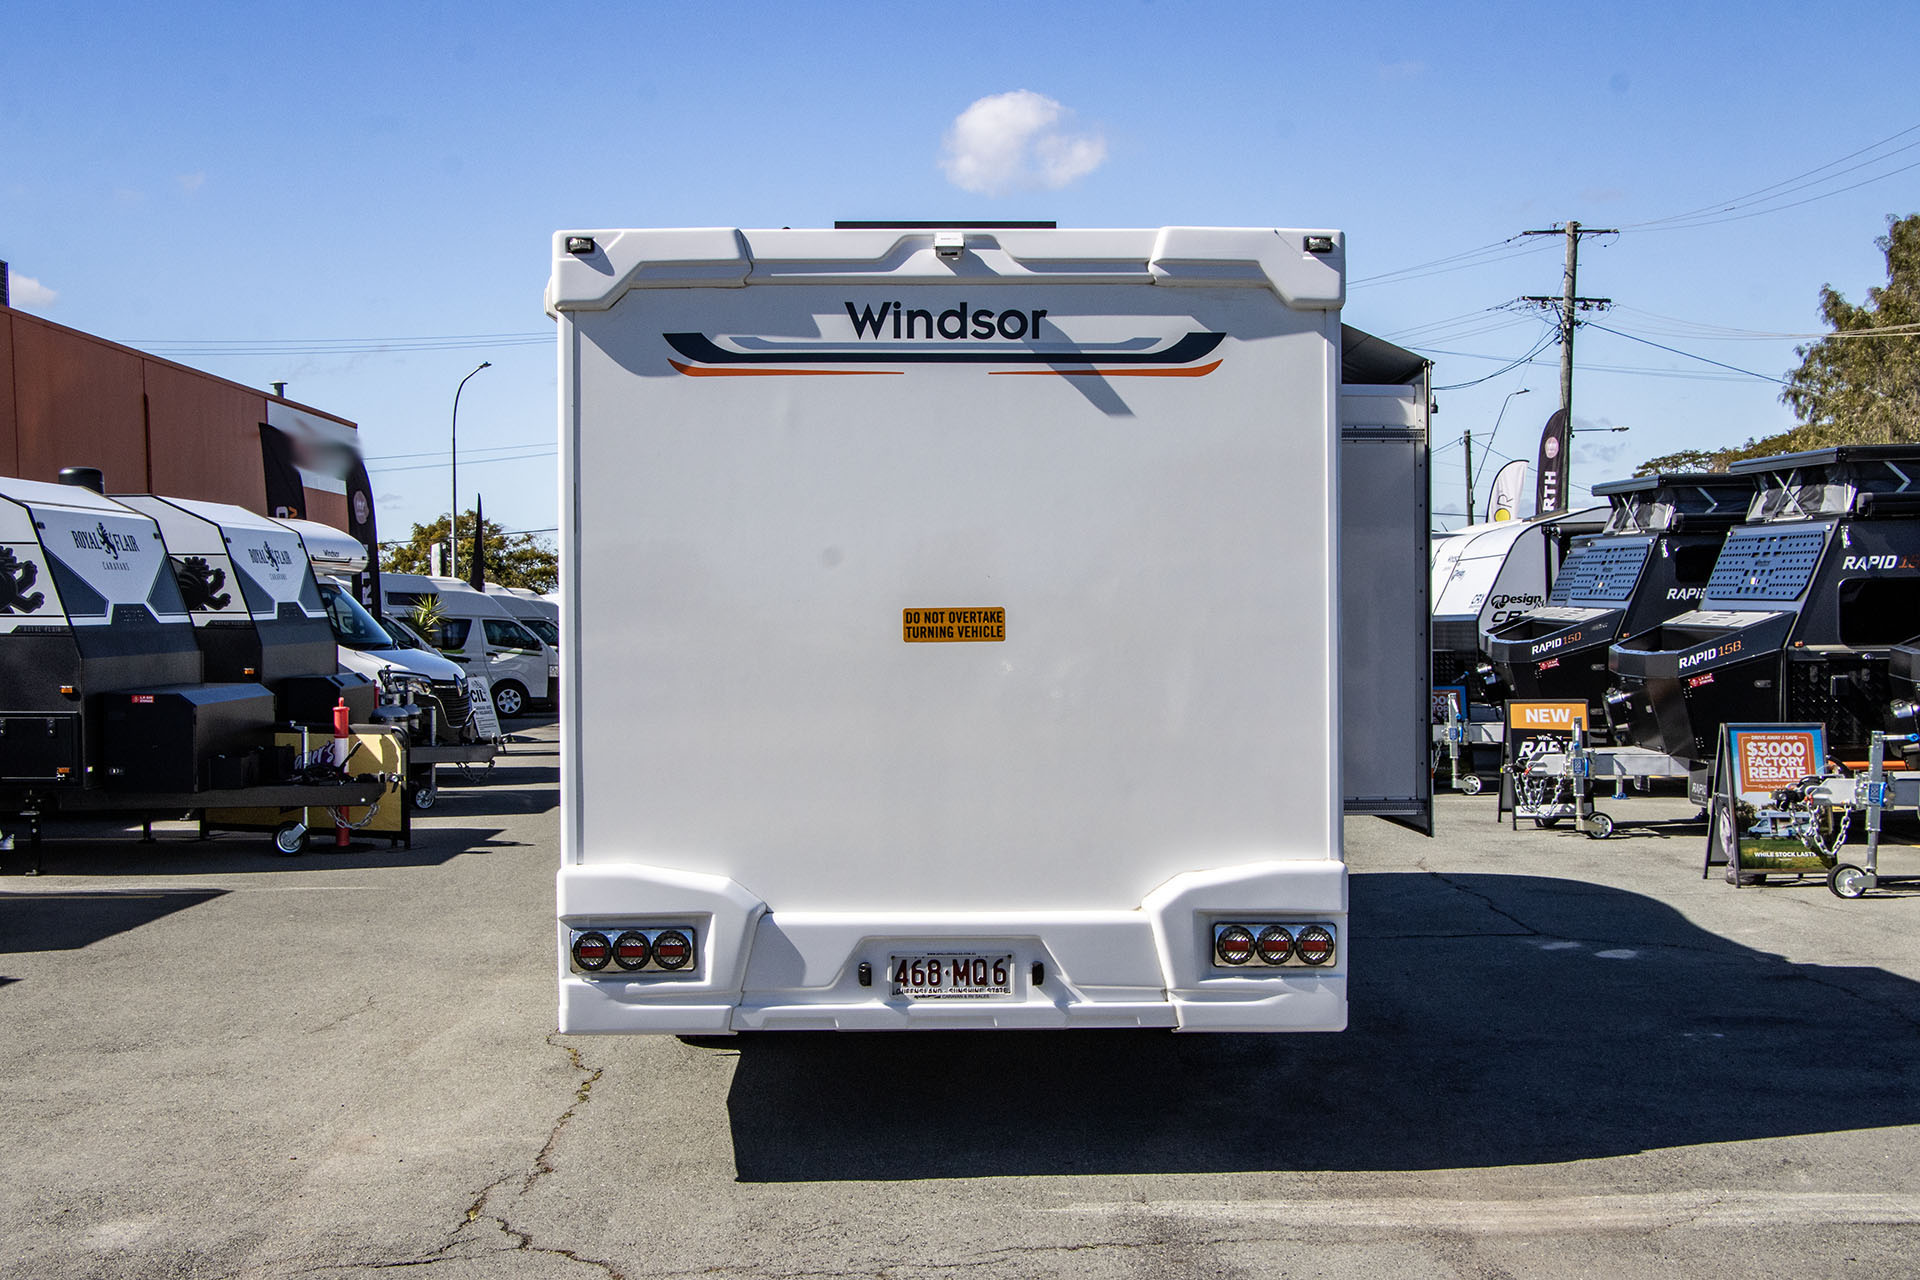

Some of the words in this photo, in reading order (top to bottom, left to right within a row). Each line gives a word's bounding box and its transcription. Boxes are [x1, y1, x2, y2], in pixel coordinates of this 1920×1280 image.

[845, 301, 1048, 340] Windsor
[71, 530, 102, 550] ROYAL
[112, 533, 140, 552] FLAIR
[1841, 555, 1898, 571] RAPID
[1501, 593, 1542, 606] Design
[905, 612, 920, 624] DO
[924, 612, 945, 624] NOT
[948, 611, 1003, 624] OVERTAKE
[905, 626, 954, 639] TURNING
[957, 625, 1003, 638] VEHICLE
[1531, 637, 1562, 656] RAPID
[1679, 648, 1717, 669] RAPID
[470, 690, 487, 703] CIL
[1525, 708, 1570, 723] NEW
[1746, 741, 1805, 757] $3,000
[1748, 756, 1805, 767] FACTORY
[1749, 767, 1806, 779] REBATE
